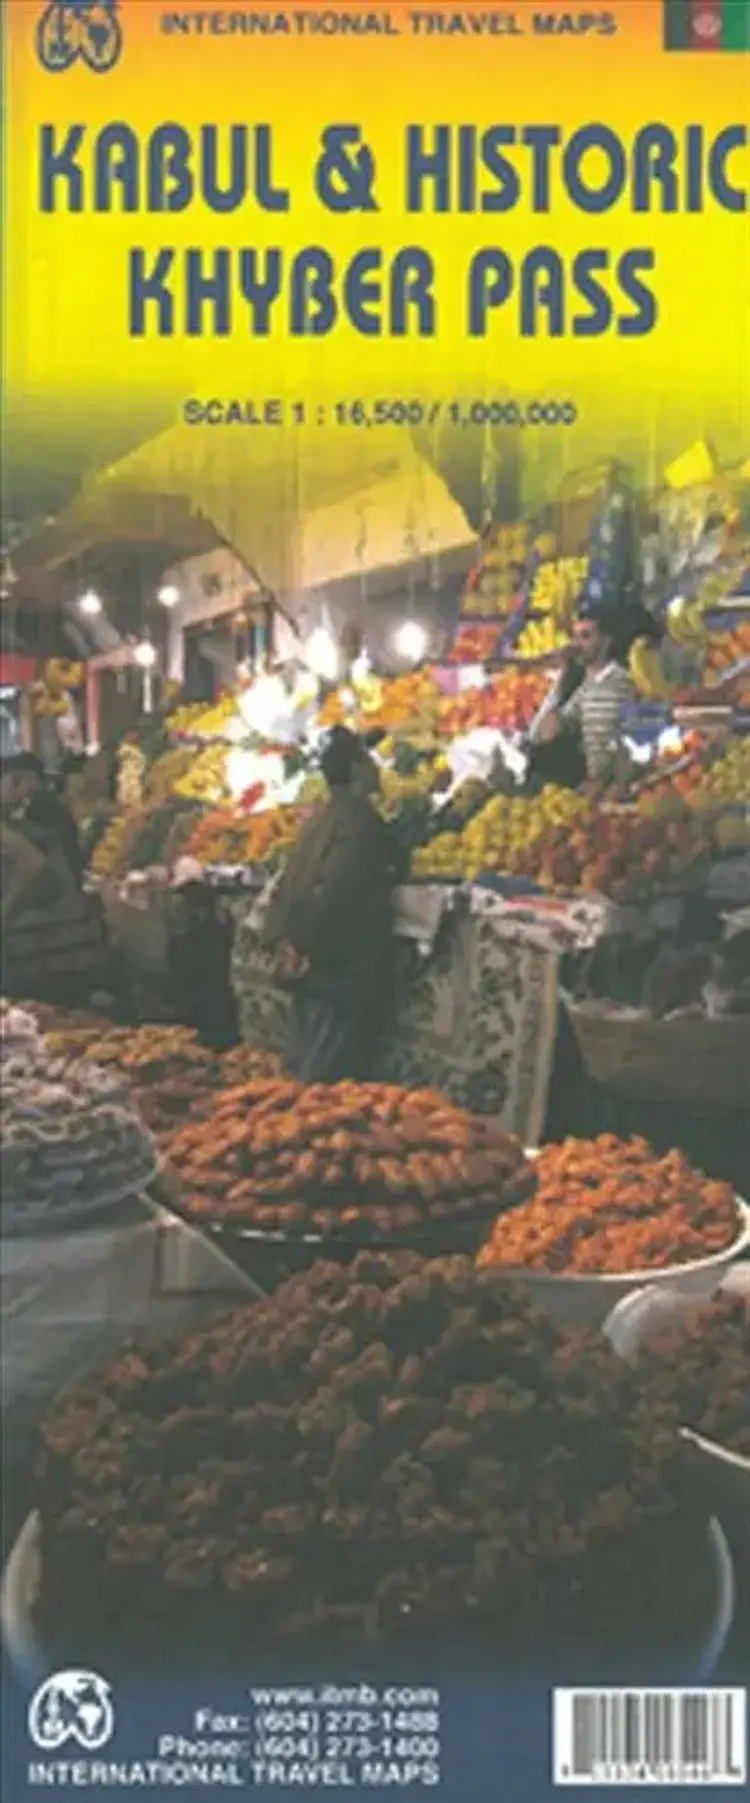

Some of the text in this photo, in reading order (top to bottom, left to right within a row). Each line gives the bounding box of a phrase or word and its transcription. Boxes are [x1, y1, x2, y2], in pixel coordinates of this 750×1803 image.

[160, 12, 617, 36] INTERNATIONAL TRAVEL MAPS
[38, 122, 748, 213] KABUL & HISTORIC
[128, 246, 657, 337] KHYBER PASS
[184, 398, 283, 426] SCALE
[195, 1708, 249, 1731] Fax:
[159, 1735, 250, 1757] Phone:
[28, 1761, 440, 1785] INTERNATIONAL TRAVEL MAPS
